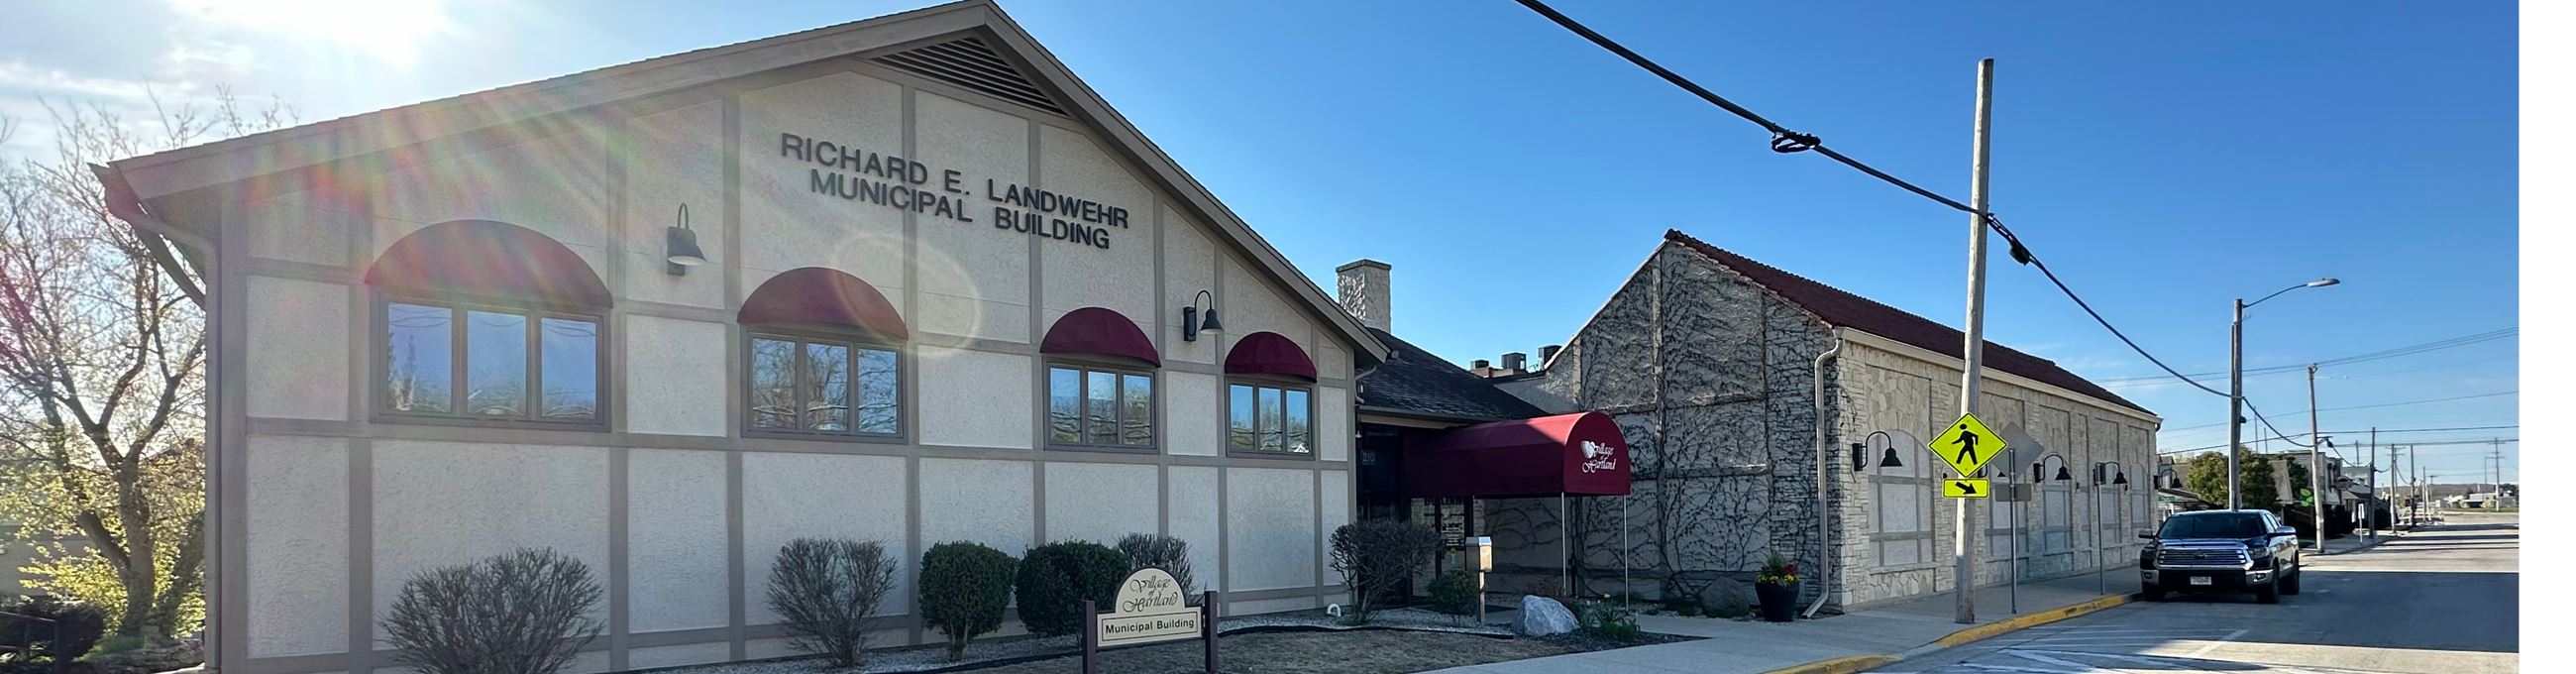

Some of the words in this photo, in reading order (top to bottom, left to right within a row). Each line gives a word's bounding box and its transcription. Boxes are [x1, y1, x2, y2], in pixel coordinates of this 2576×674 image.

[782, 133, 928, 185] RICHARD
[944, 169, 971, 195] E.
[988, 178, 1129, 229] LANDWEHR
[810, 168, 973, 223] MUNICIPAL
[995, 206, 1110, 249] BUILDING
[1129, 576, 1170, 593] Village
[1123, 592, 1178, 613] Hartland
[1106, 621, 1153, 633] Municipal
[1156, 619, 1195, 629] Building
